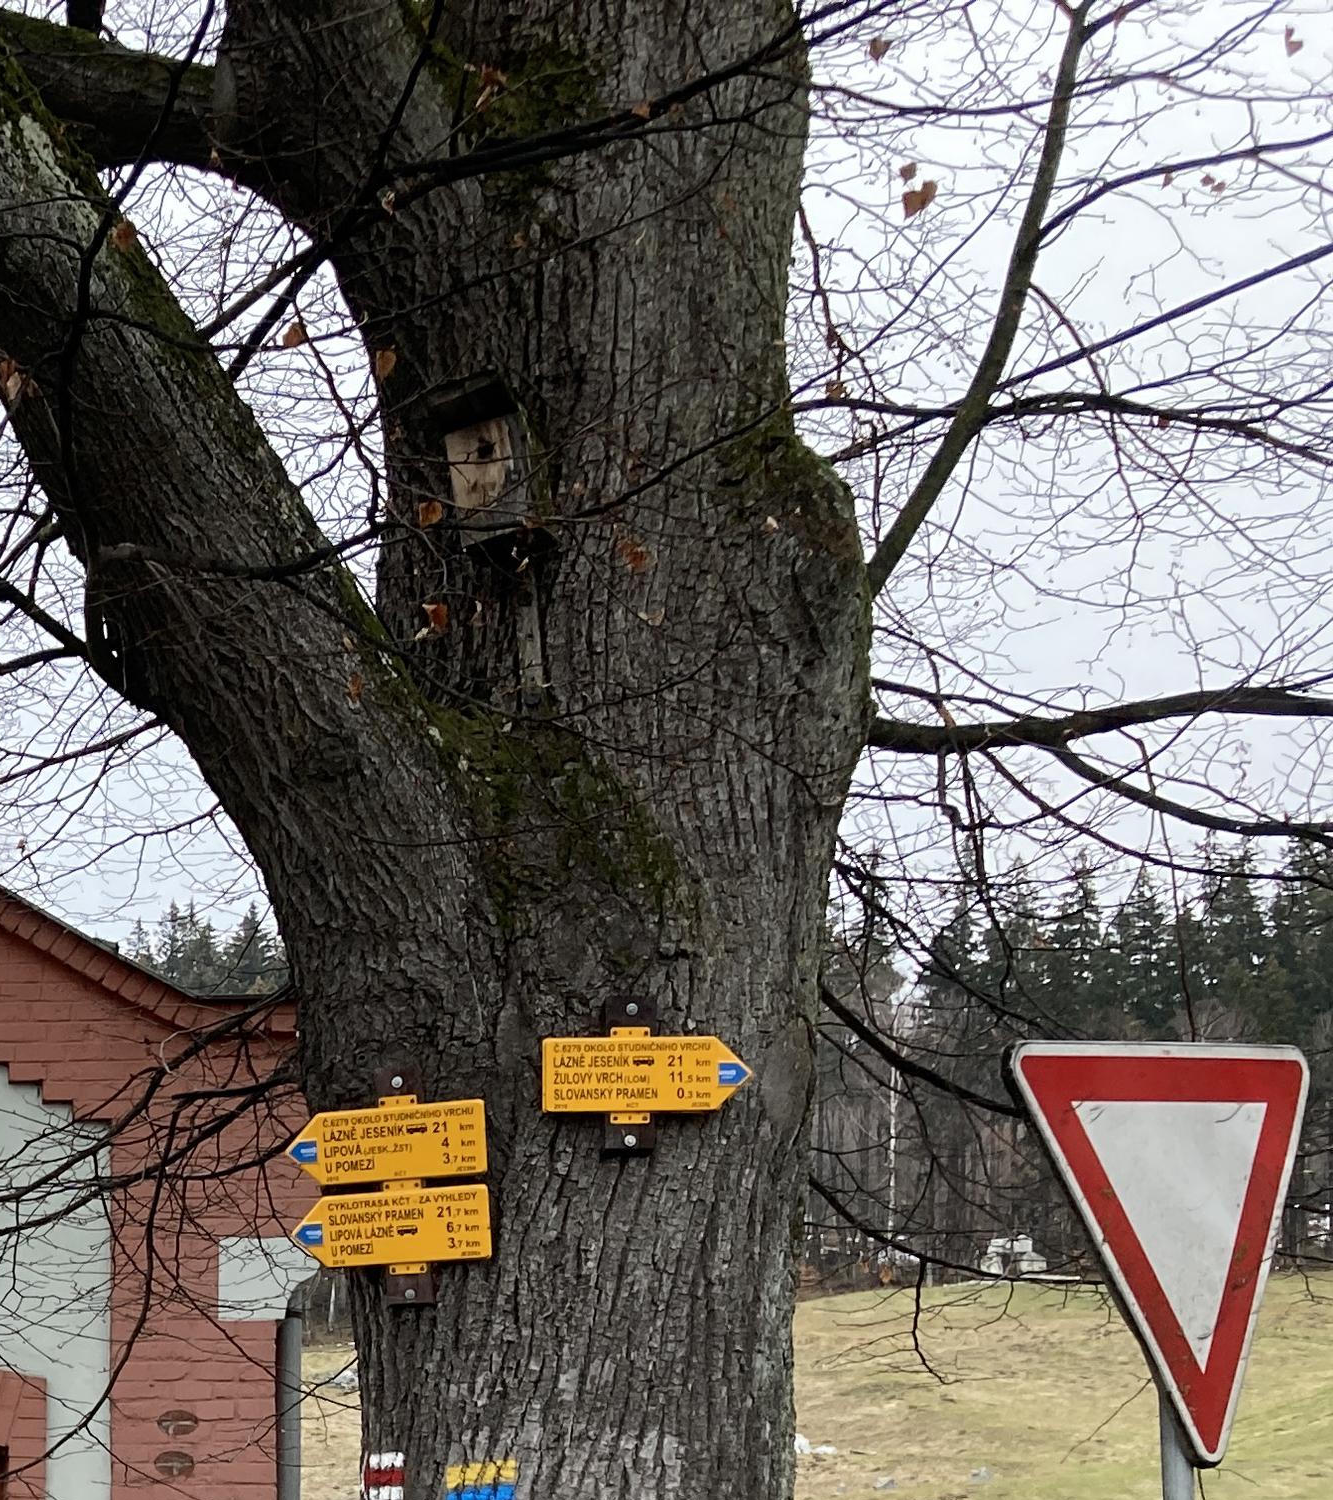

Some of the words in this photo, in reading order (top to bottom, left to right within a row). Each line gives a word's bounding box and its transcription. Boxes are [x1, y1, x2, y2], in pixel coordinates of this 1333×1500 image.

[583, 1043, 615, 1053] OKOLO
[680, 1043, 711, 1052] VRCHU
[553, 1053, 585, 1068] LÁZNĚ
[588, 1053, 630, 1068] JESENÍK
[667, 1054, 683, 1067] 21
[696, 1058, 711, 1067] km
[554, 1070, 593, 1085] ŽULOVÝ
[595, 1072, 623, 1084] VRCH
[696, 1074, 711, 1083] km
[554, 1085, 613, 1101] SLOVANSKÝ
[616, 1087, 658, 1100] PRAMEN
[696, 1090, 711, 1099] km
[351, 1115, 381, 1126] OKOLO
[443, 1106, 474, 1117] VRCHU
[323, 1126, 357, 1143] LÁZNĚ
[360, 1122, 406, 1140] JESENÍK
[432, 1120, 448, 1134] 21
[459, 1123, 475, 1131] km
[324, 1141, 363, 1159] LIPOVÁ
[441, 1136, 450, 1148] 4
[461, 1138, 476, 1147] km
[325, 1161, 333, 1174] U
[335, 1155, 375, 1173] POMEZÍ
[461, 1154, 476, 1163] km
[327, 1199, 390, 1211] CYKLOTRASA
[392, 1196, 410, 1206] KČT
[419, 1195, 431, 1204] ZA
[433, 1191, 478, 1203] VÝHLEDY
[328, 1209, 382, 1226] SLOVANSKÝ
[385, 1207, 424, 1222] PRAMEN
[463, 1207, 479, 1216] km
[329, 1225, 362, 1242] LIPOVÁ
[364, 1223, 394, 1240] LÁZNĚ
[465, 1223, 480, 1232] km
[331, 1245, 337, 1257] U
[465, 1239, 481, 1248] km
